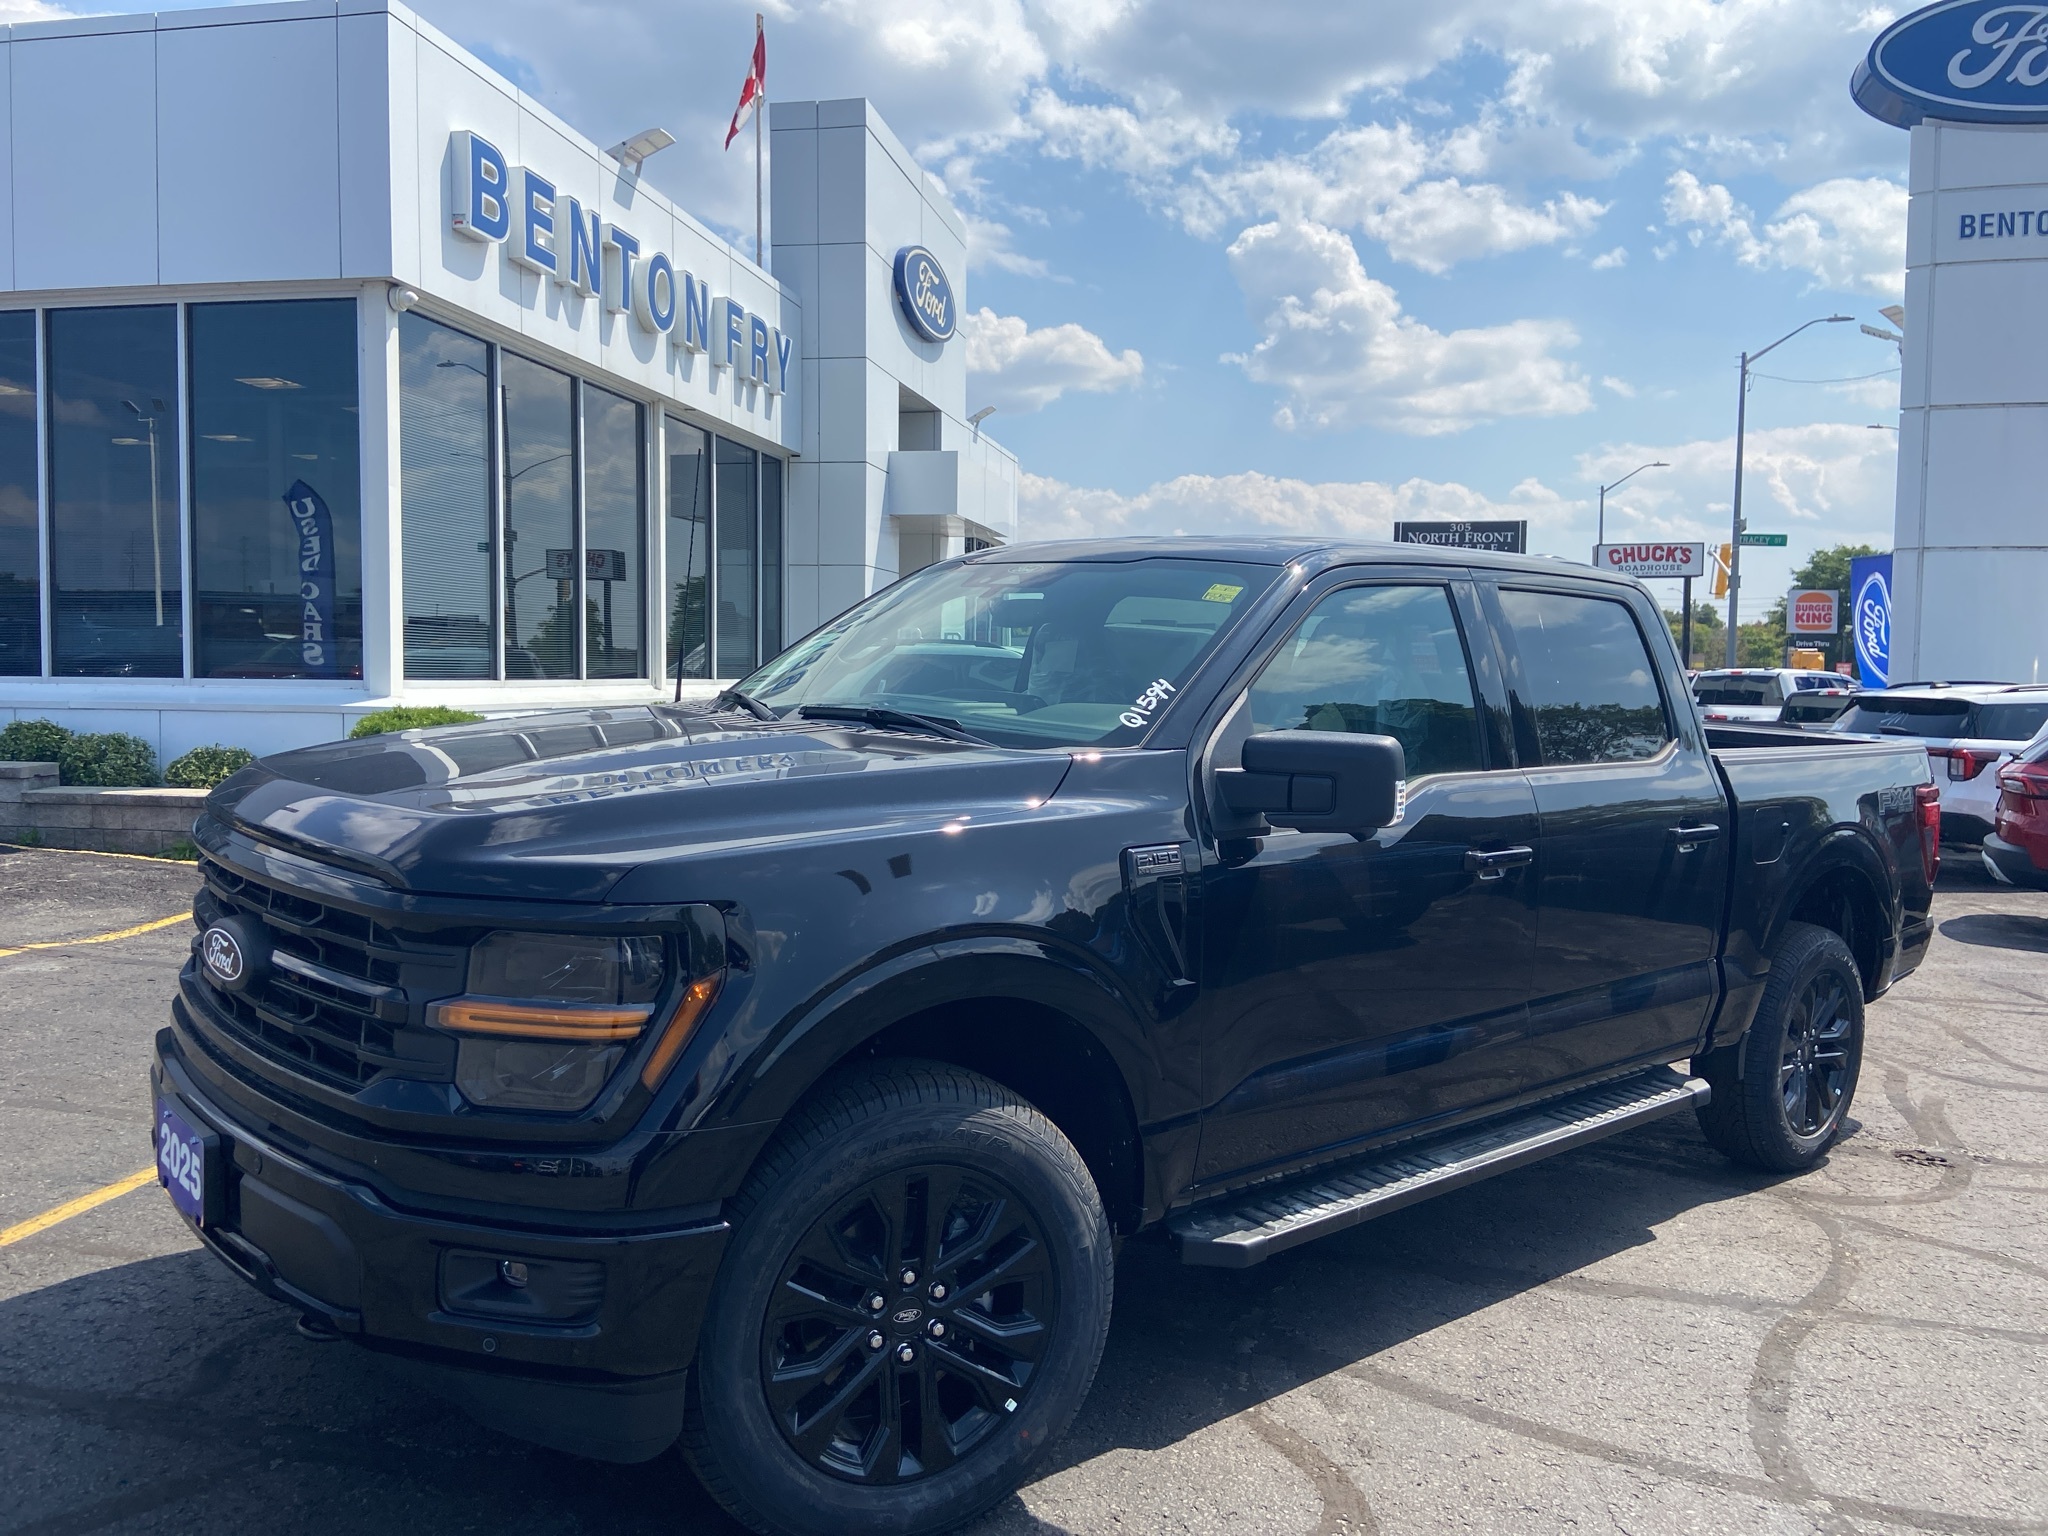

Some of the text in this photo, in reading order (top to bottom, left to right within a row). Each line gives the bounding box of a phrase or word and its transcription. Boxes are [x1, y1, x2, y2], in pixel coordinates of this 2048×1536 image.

[469, 131, 792, 396] BENTON FRY
[915, 260, 946, 328] Ford
[1407, 531, 1514, 544] NORTH FRONT
[1449, 523, 1471, 532] 305
[1608, 545, 1692, 565] CHUCK'S
[1618, 564, 1683, 572] ROADHOUSE
[1795, 604, 1832, 612] BURGER
[1795, 612, 1832, 623] KING
[1863, 599, 1888, 660] Ford
[1878, 787, 1915, 816] FX4
[209, 932, 235, 976] Ford
[160, 1122, 202, 1201] 2025
